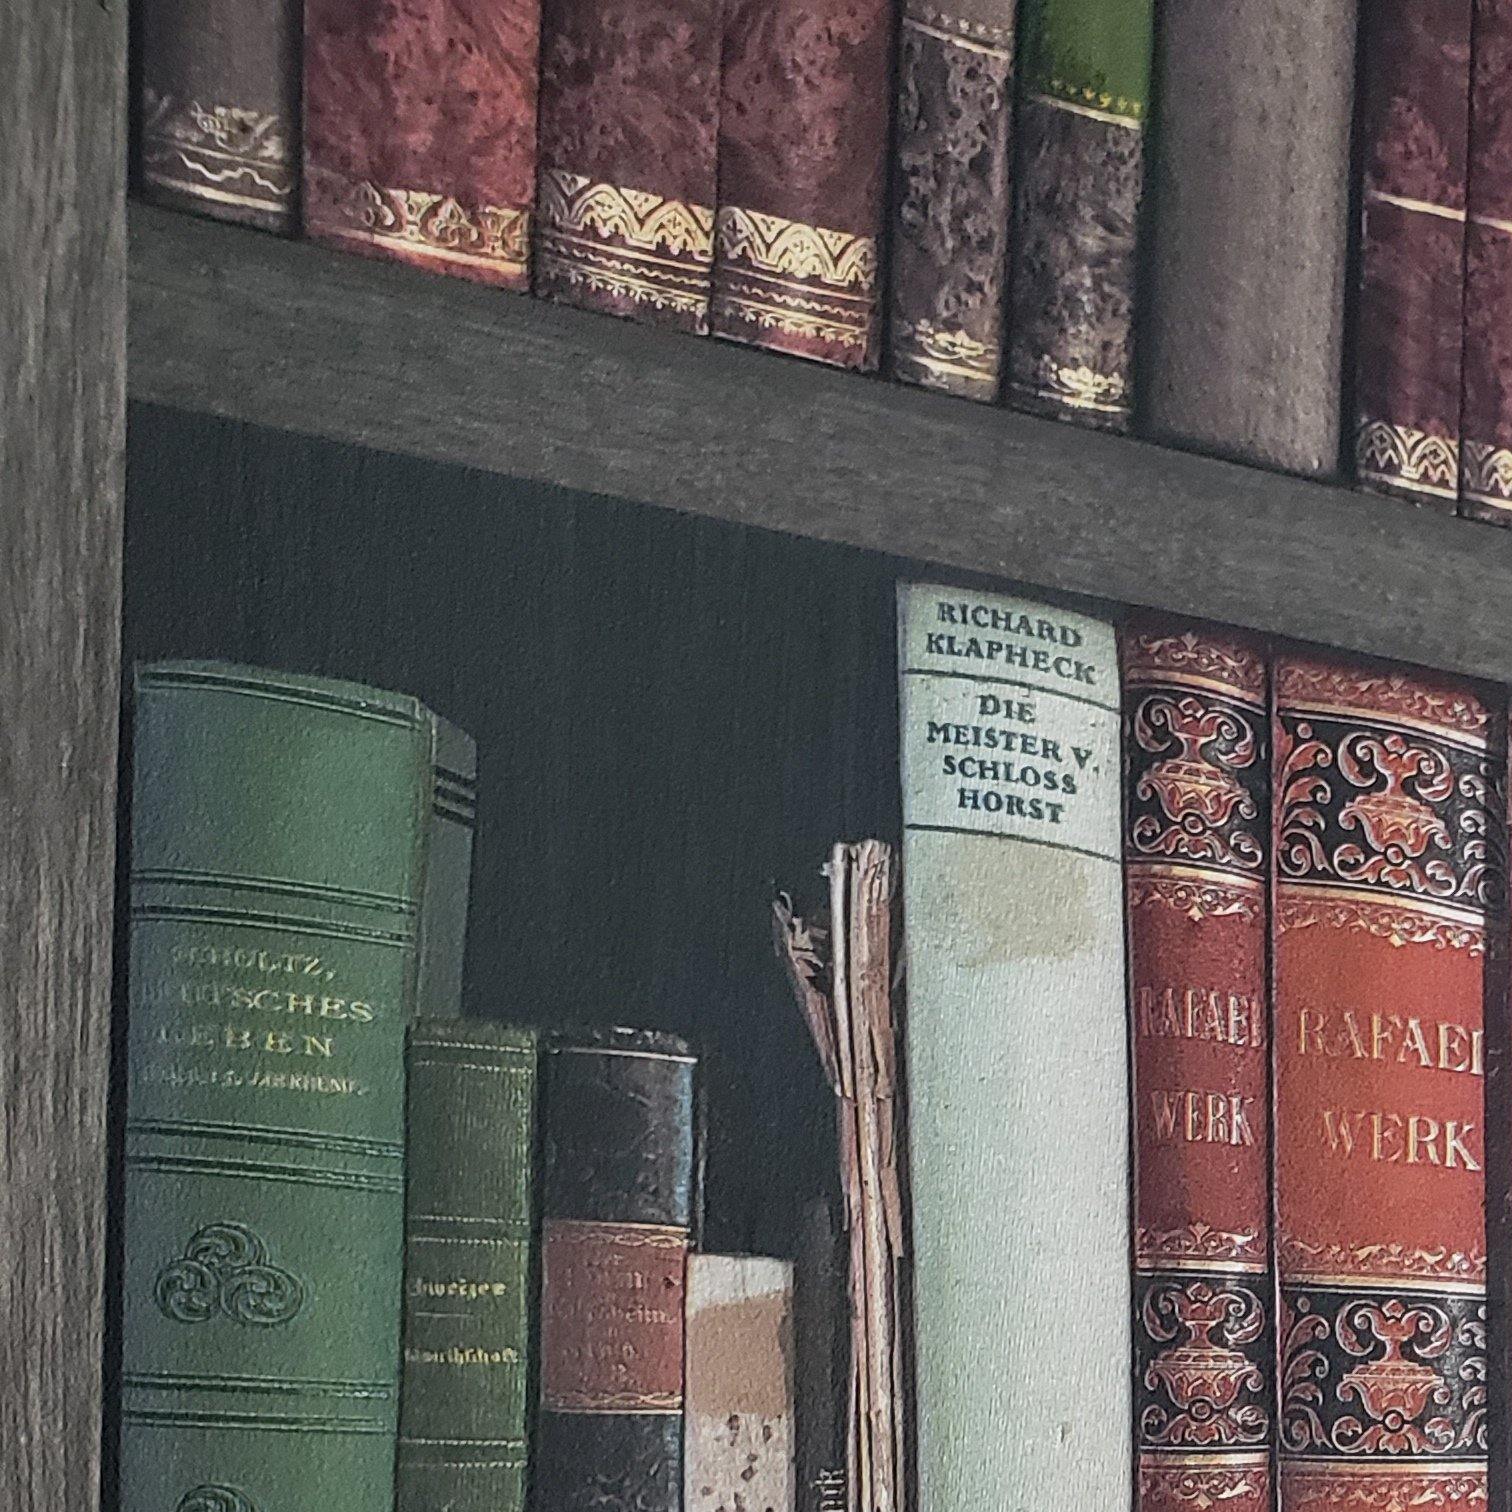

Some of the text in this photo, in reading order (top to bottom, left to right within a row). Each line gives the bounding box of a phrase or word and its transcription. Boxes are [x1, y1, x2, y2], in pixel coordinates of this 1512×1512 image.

[937, 602, 1083, 648] RICHARD
[926, 632, 1097, 685] KLAPHECK
[978, 694, 1036, 724] DIE
[927, 721, 1063, 763] MEISTER
[942, 755, 1077, 795] SCHLOSS
[957, 788, 1066, 824] HORST
[1150, 1089, 1256, 1146] WERK
[1322, 1110, 1483, 1172] WERK
